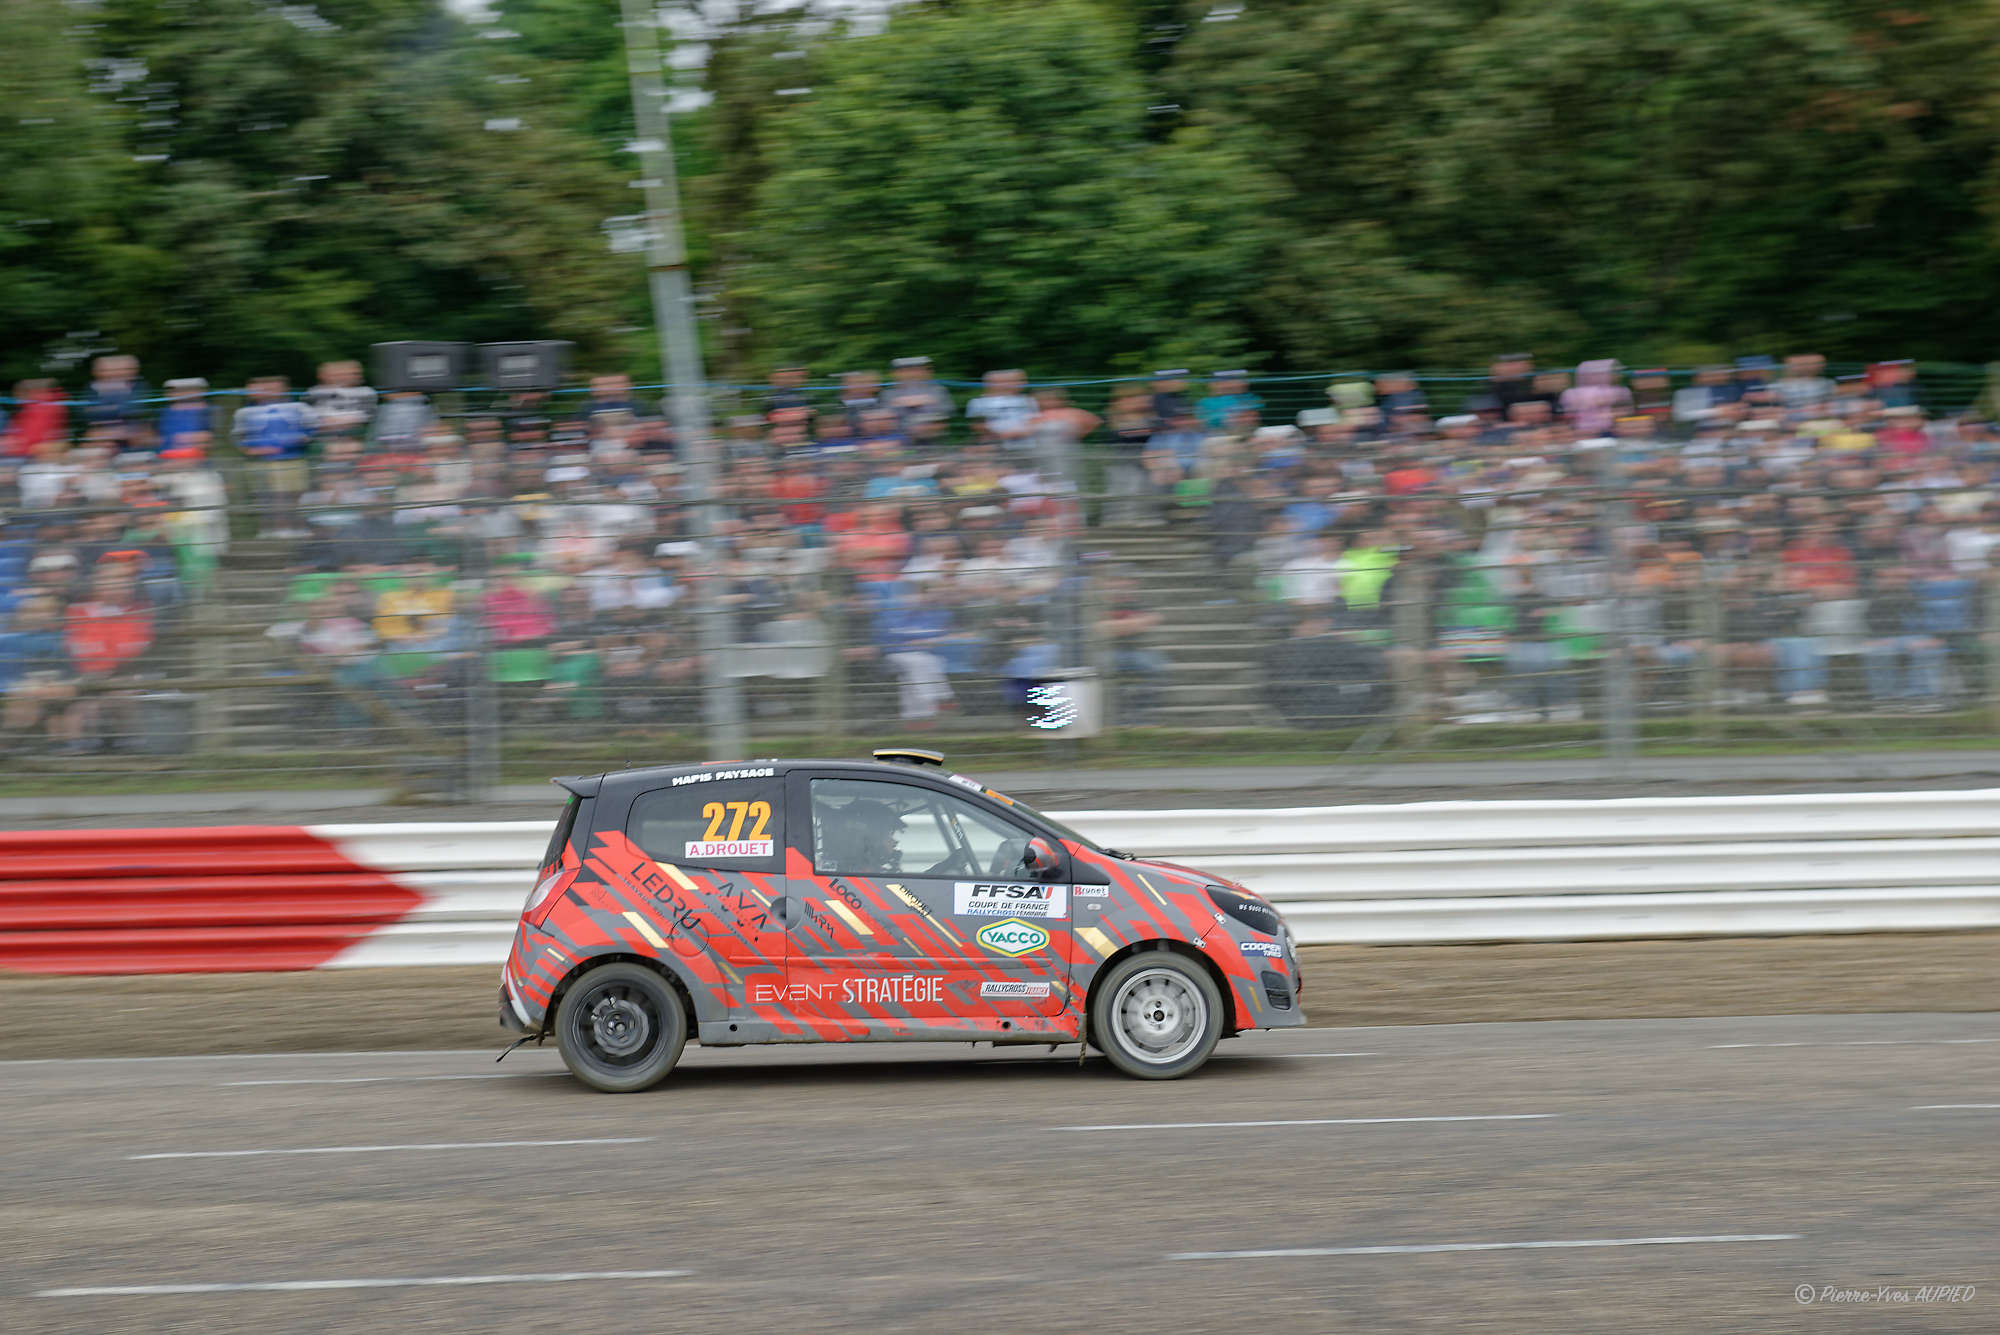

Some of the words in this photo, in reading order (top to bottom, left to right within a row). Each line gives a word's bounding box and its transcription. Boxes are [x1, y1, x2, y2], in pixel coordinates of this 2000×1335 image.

[716, 767, 774, 781] PAYSAGE
[702, 801, 772, 842] 272
[690, 842, 769, 856] A.DROUET
[631, 861, 701, 930] LEDRU
[971, 884, 1043, 899] FFSA
[1015, 903, 1049, 911] FRANCE
[987, 931, 1041, 944] YACCO
[1240, 942, 1281, 953] COOPER
[755, 983, 839, 1001] EVENT
[984, 984, 1026, 993] RALLYCROSS
